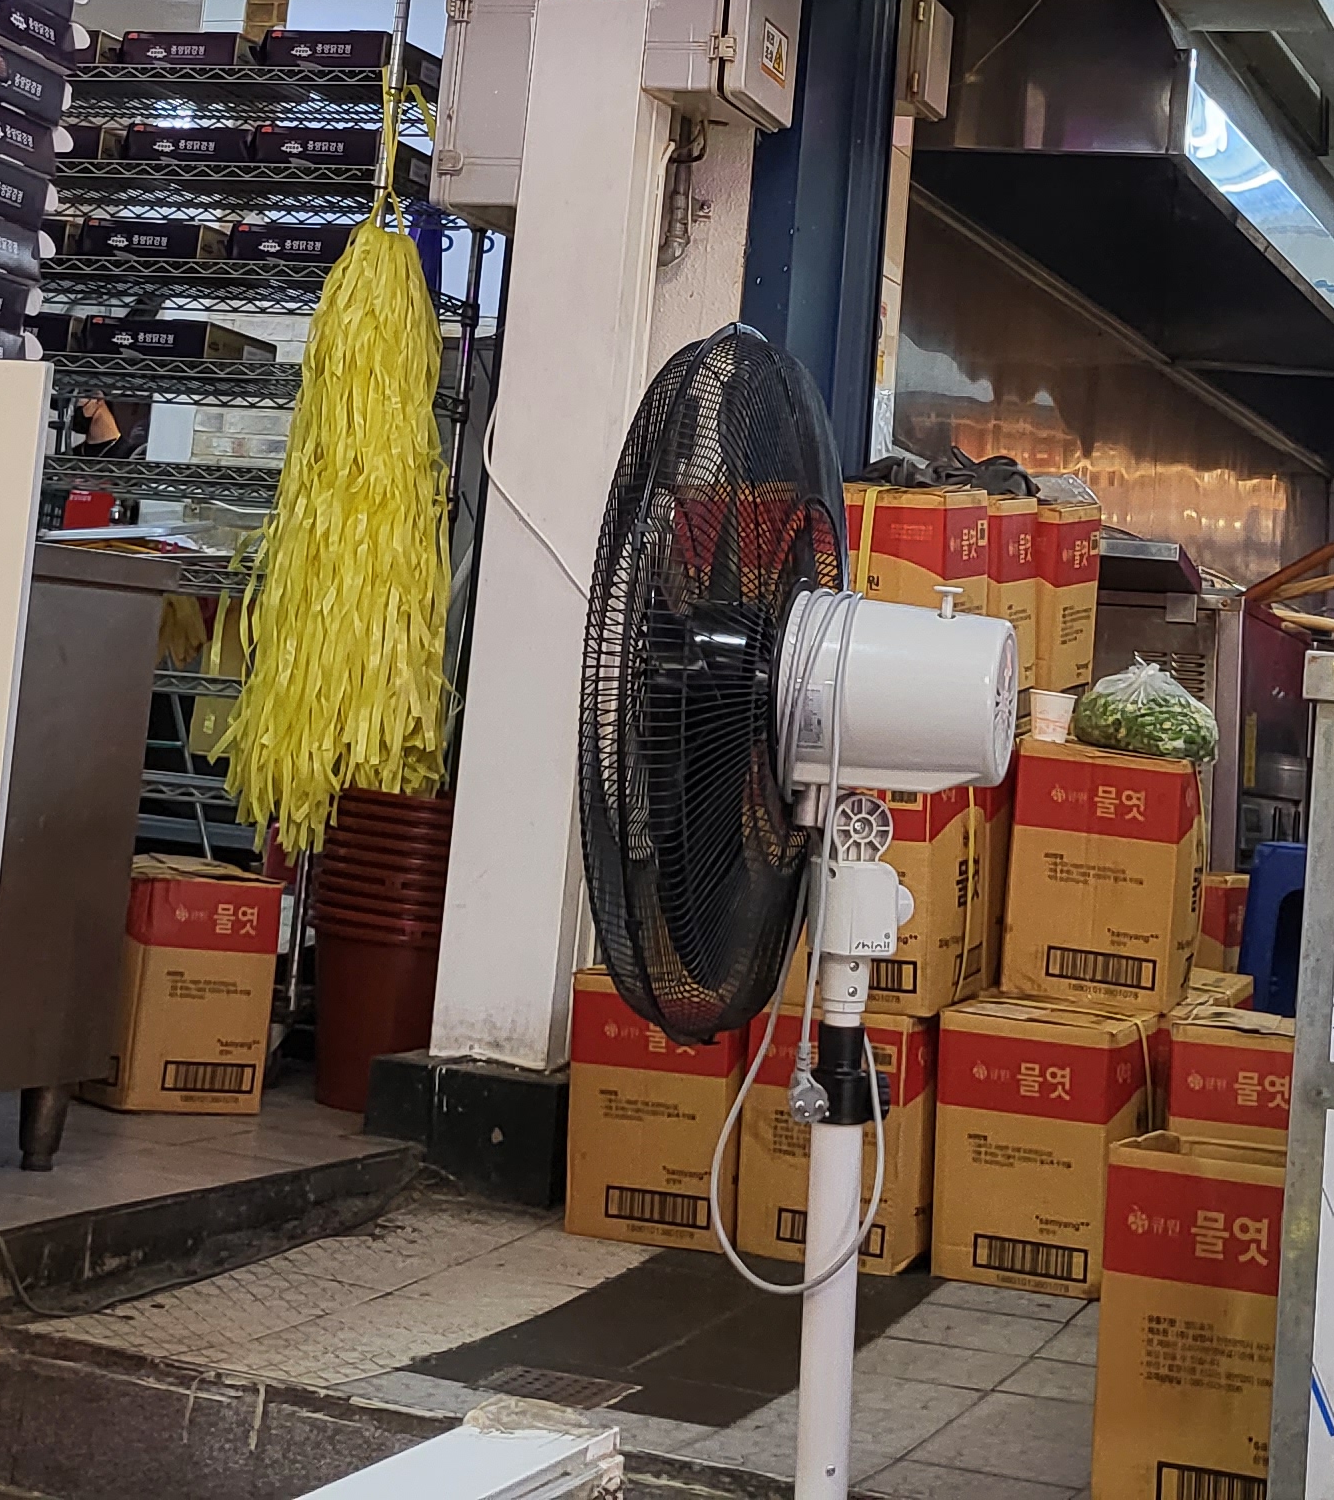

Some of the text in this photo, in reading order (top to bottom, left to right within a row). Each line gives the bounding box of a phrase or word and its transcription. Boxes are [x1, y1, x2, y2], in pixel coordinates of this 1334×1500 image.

[1094, 785, 1146, 821] 물엿
[213, 903, 259, 936] 물엿
[1017, 1061, 1071, 1101] 물엿
[1234, 1071, 1290, 1111] 물엿
[1191, 1209, 1271, 1267] 물엿
